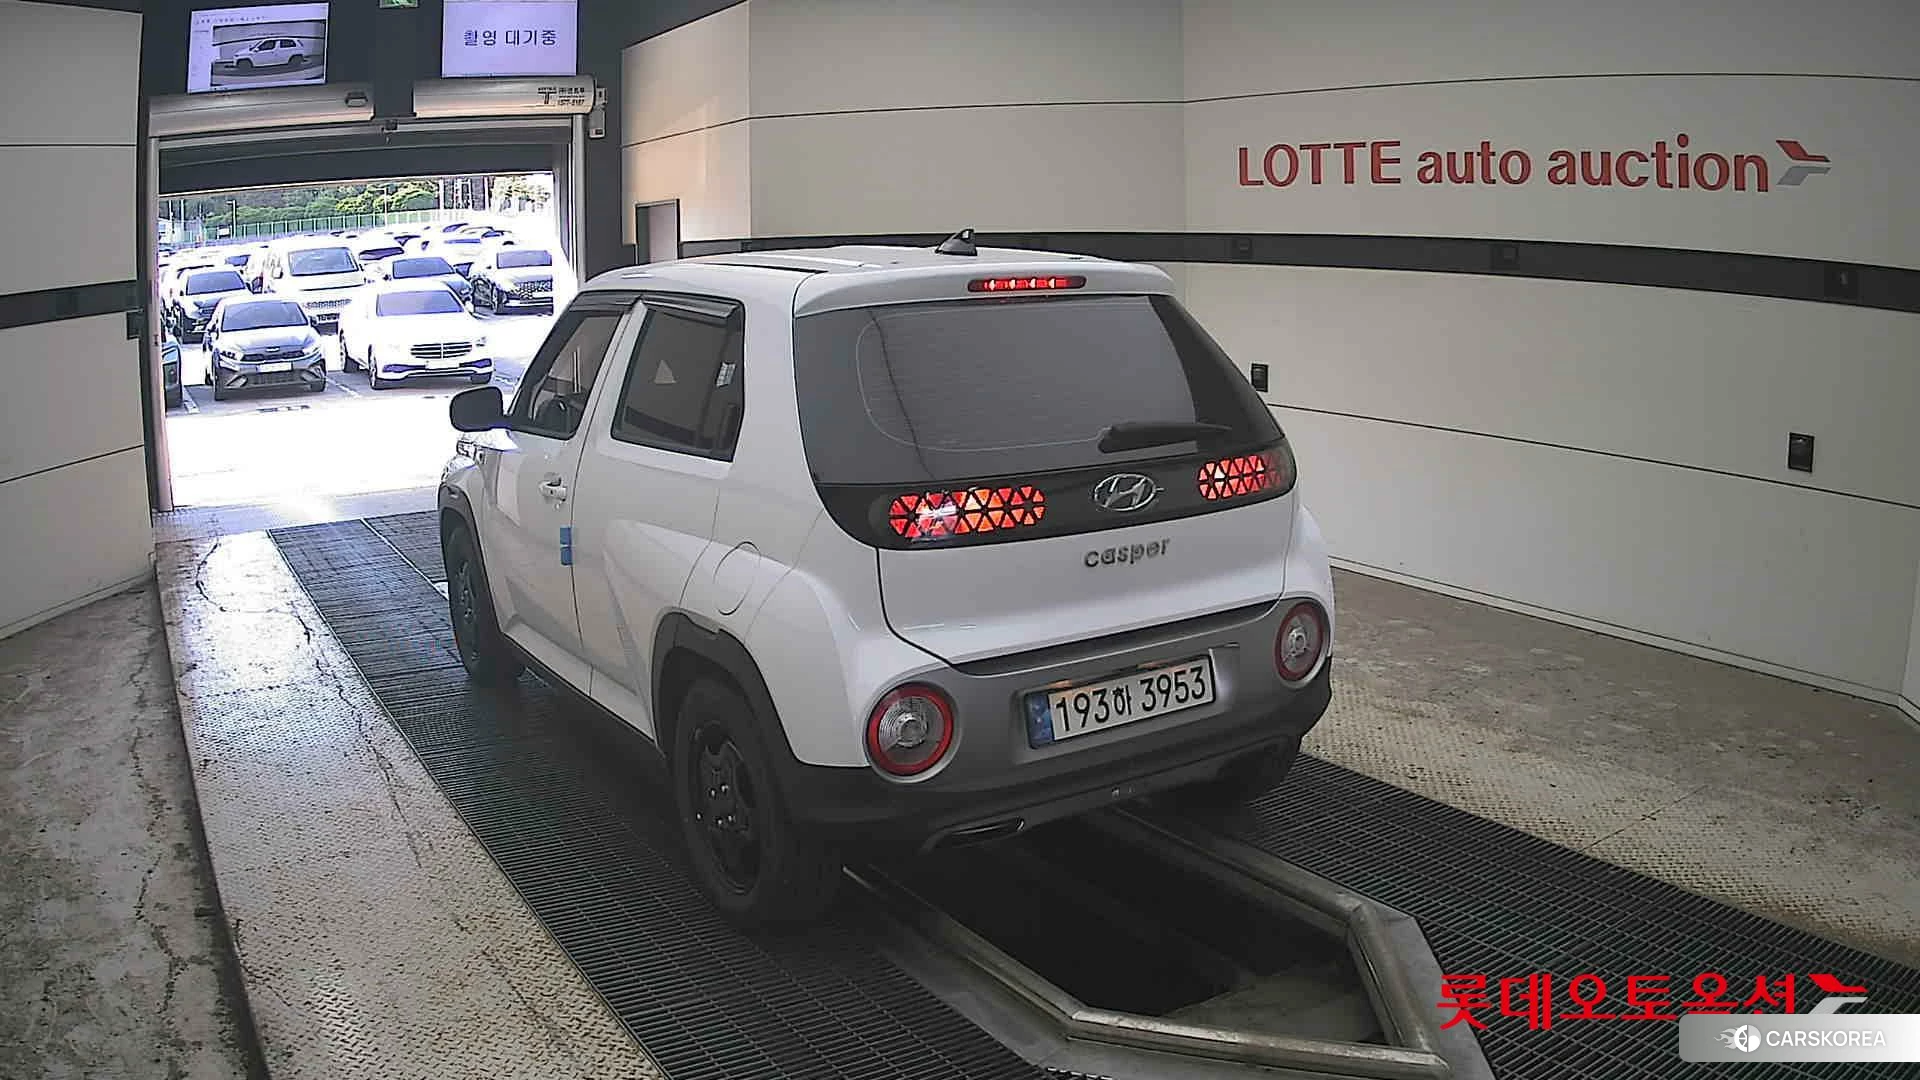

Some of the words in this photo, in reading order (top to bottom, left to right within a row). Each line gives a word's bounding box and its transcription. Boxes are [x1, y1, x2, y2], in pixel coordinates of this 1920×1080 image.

[505, 29, 557, 47] 대기중
[1238, 140, 1401, 188] LOTTE
[1416, 140, 1532, 185] auto
[1547, 133, 1769, 193] auction
[1084, 538, 1170, 568] casper
[1054, 683, 1132, 732] 193하
[1139, 666, 1206, 712] 3953
